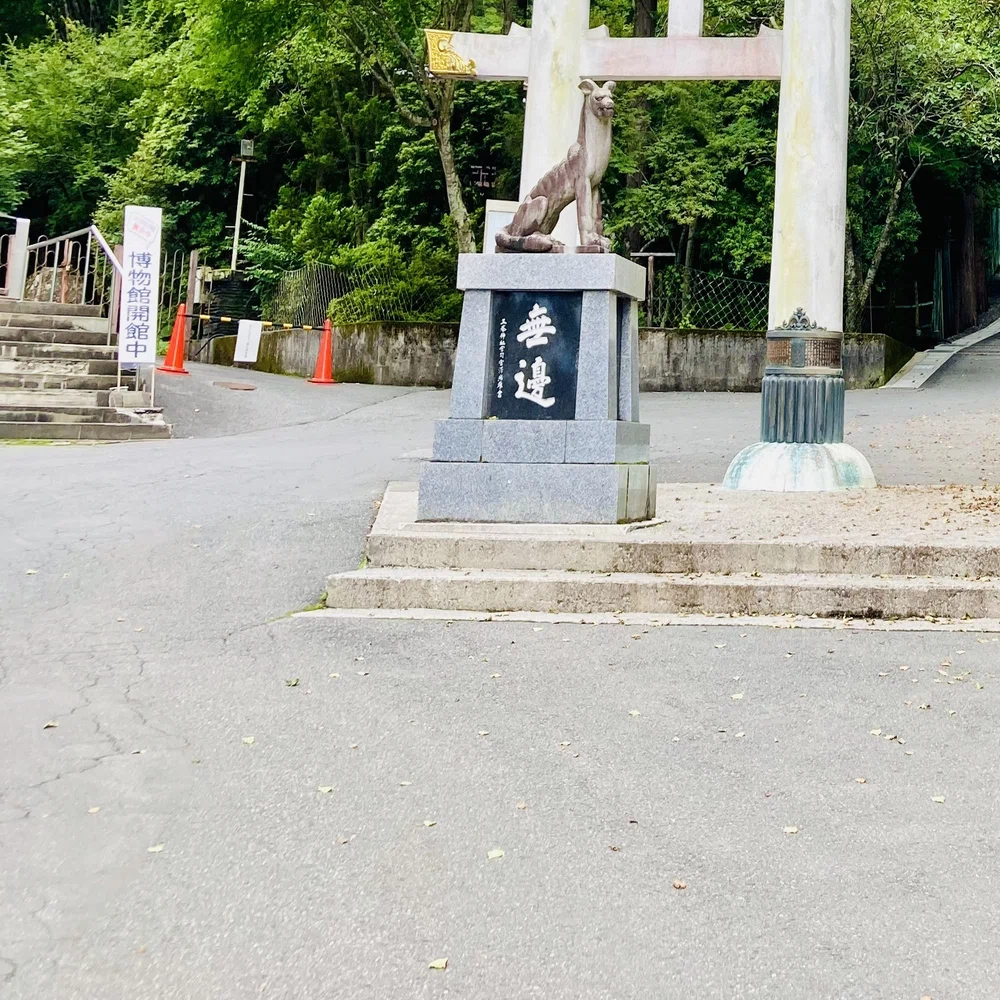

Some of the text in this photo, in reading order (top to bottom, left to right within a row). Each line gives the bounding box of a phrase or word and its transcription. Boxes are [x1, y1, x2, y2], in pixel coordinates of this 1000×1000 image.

[125, 251, 152, 358] 博物館開館中
